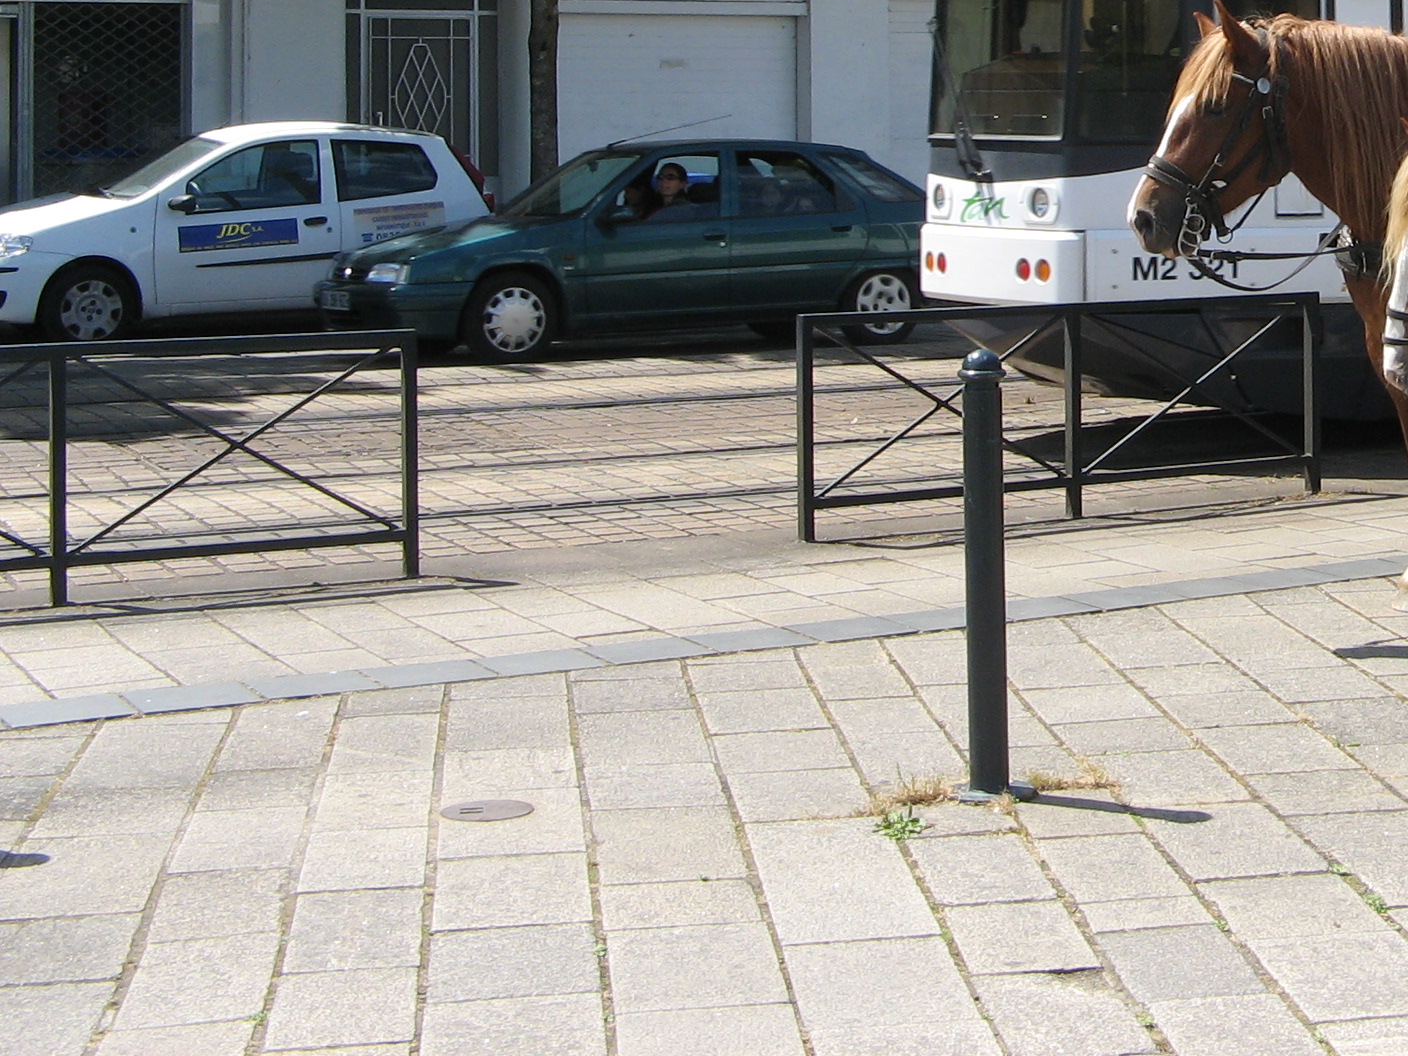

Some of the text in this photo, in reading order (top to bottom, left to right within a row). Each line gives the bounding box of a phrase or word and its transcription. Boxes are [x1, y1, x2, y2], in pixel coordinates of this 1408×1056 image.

[960, 191, 1010, 223] tan
[216, 223, 251, 239] JDC
[1132, 256, 1178, 281] M2
